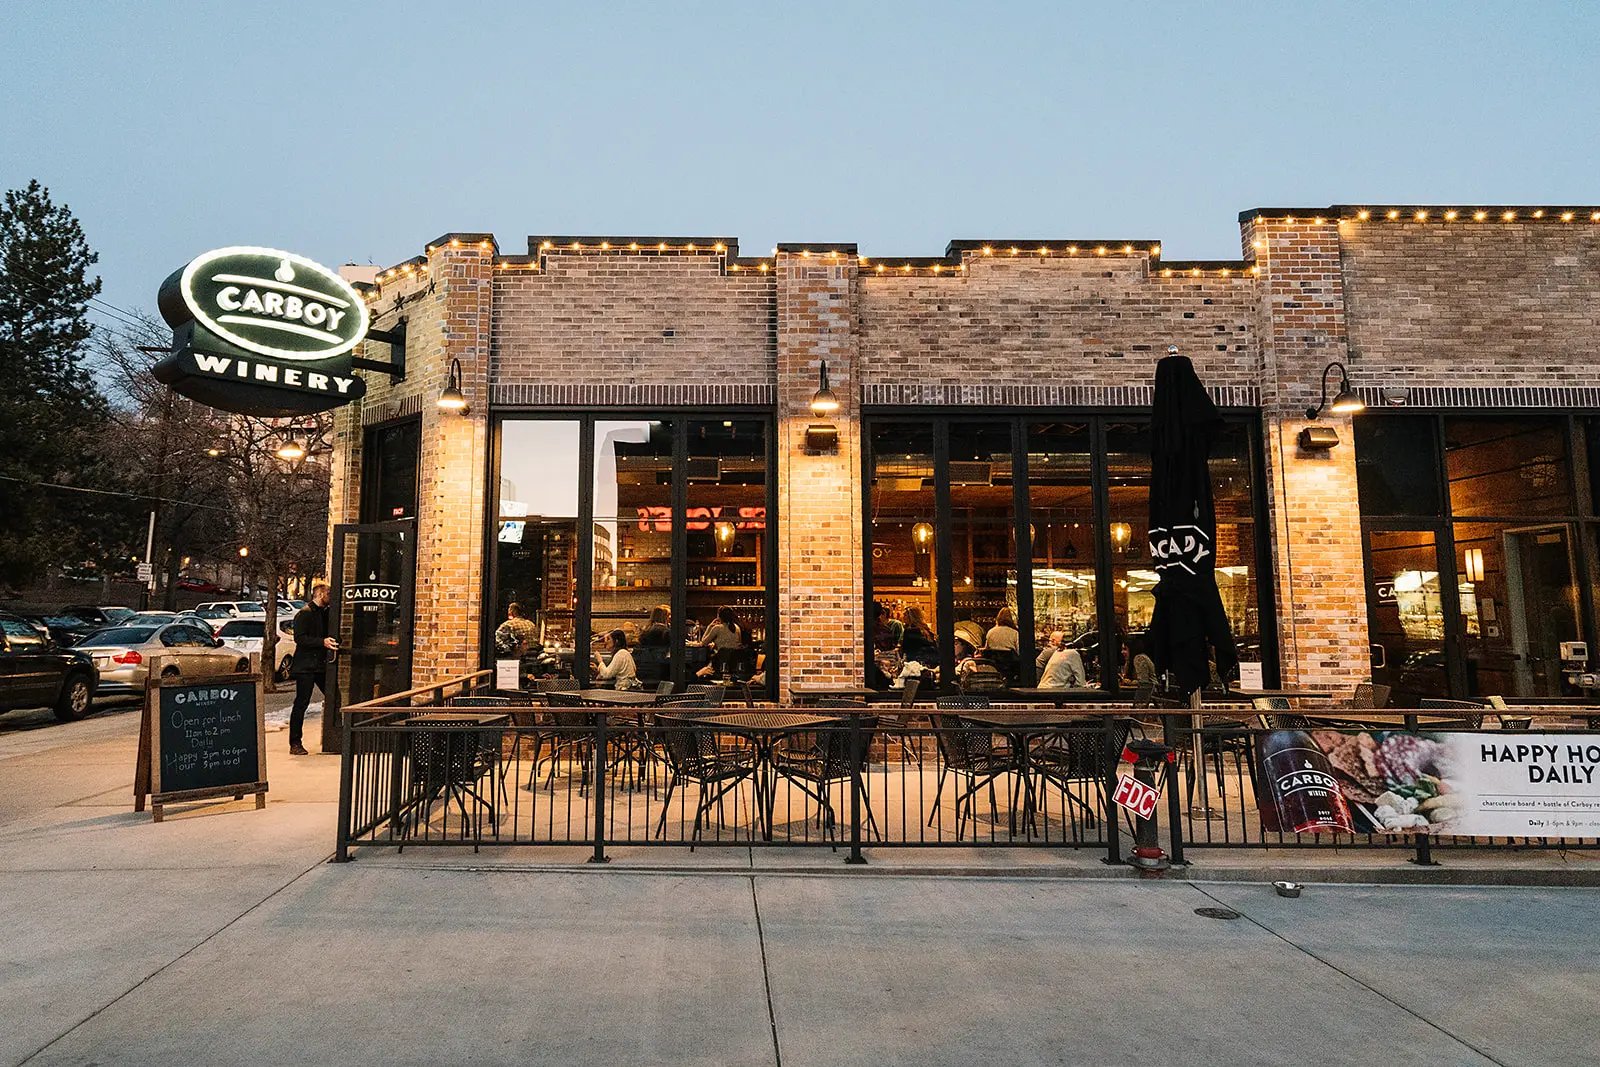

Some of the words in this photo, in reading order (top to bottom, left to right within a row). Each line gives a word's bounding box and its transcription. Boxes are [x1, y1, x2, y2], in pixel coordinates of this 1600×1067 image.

[216, 286, 346, 331] CARBOY
[193, 353, 354, 394] WINERY
[345, 588, 398, 600] CARBOY
[174, 688, 239, 704] CARBOY
[171, 710, 200, 730] Open
[202, 715, 217, 728] for
[219, 709, 242, 723] lunch
[1481, 744, 1558, 763] HAPPY
[1566, 745, 1600, 763] HO
[1528, 765, 1595, 783] DAILY
[1115, 778, 1156, 815] FDC
[1570, 800, 1592, 809] Carboy
[1528, 819, 1544, 828] Daily
